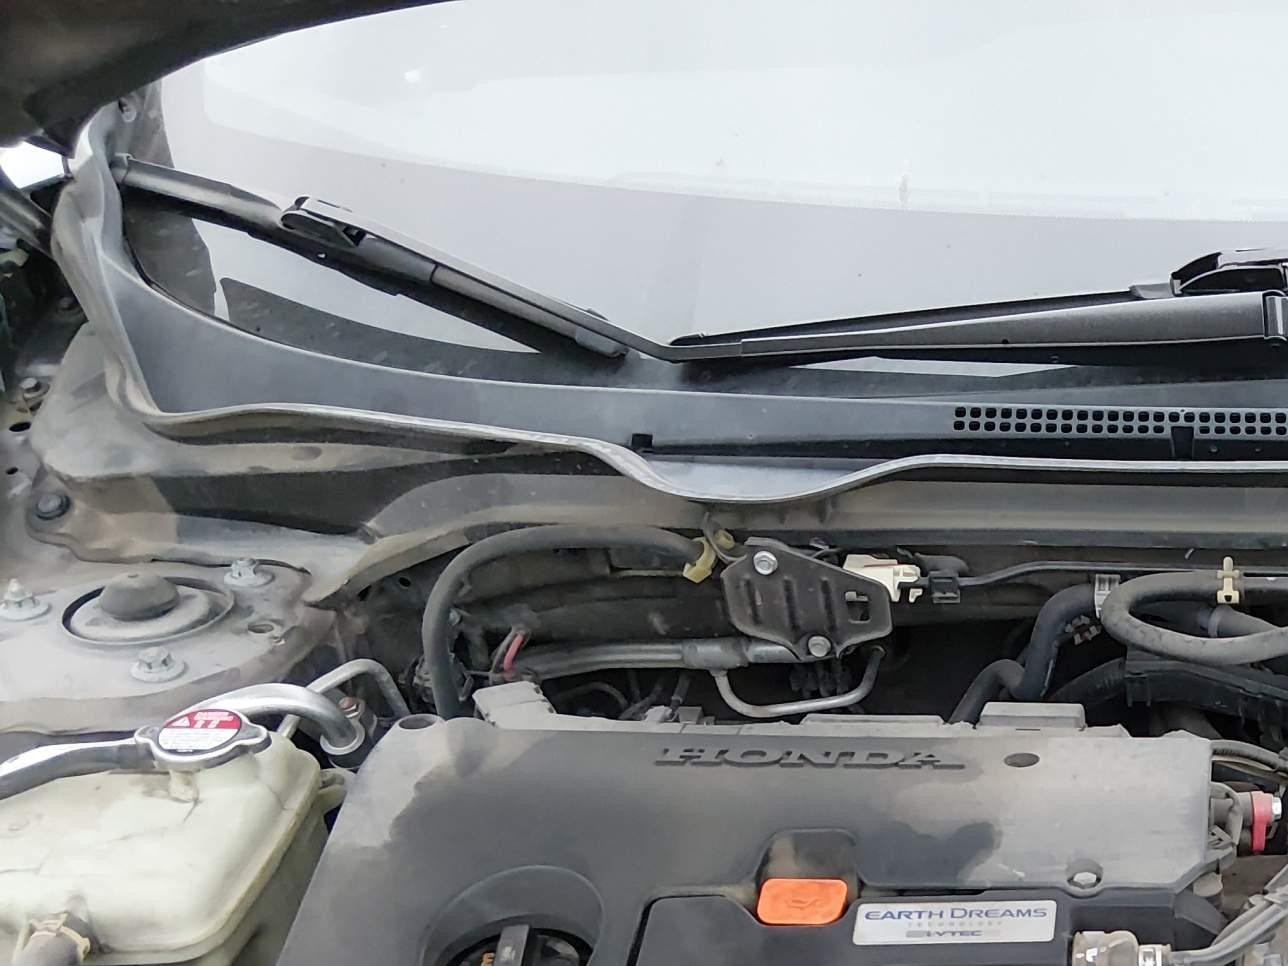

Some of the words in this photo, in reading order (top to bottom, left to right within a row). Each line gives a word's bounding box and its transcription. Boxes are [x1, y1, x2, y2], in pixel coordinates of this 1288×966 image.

[655, 747, 965, 769] HONDA
[864, 910, 944, 921] EARTH
[950, 908, 1048, 919] DREAMS
